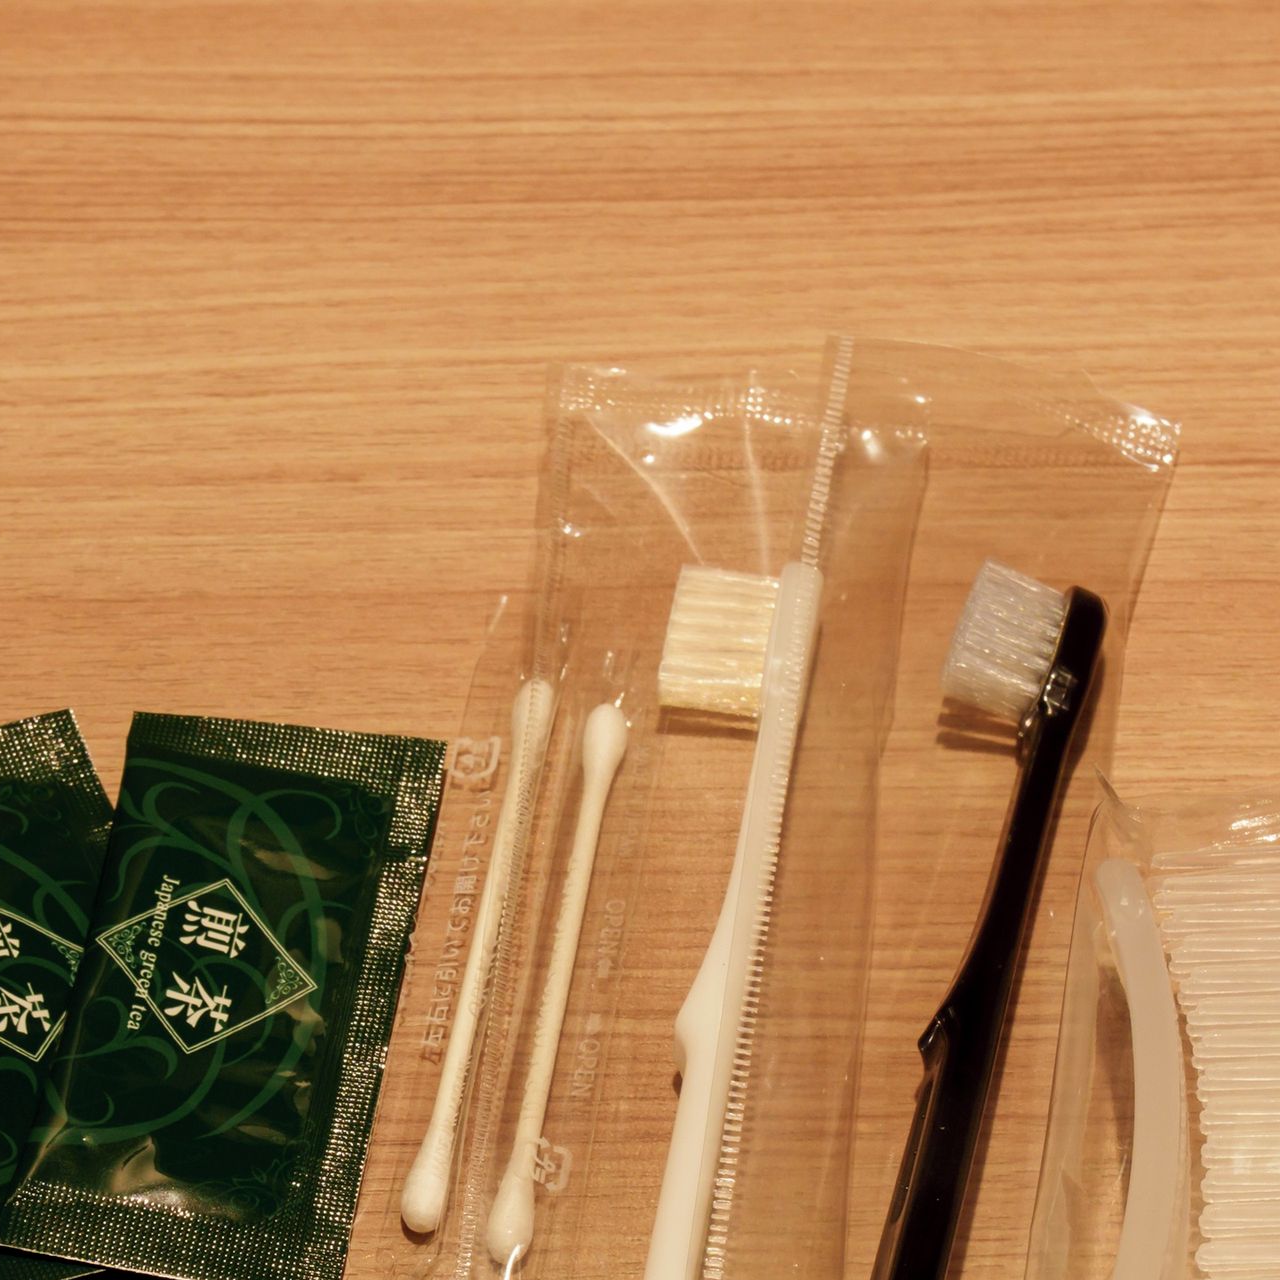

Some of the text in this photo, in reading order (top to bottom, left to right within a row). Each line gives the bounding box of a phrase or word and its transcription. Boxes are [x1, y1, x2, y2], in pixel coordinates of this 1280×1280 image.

[127, 874, 181, 1031] Japanese green tea
[163, 900, 250, 1033] 煎茶
[598, 900, 626, 952] OPEN
[571, 1039, 601, 1100] OPEN
